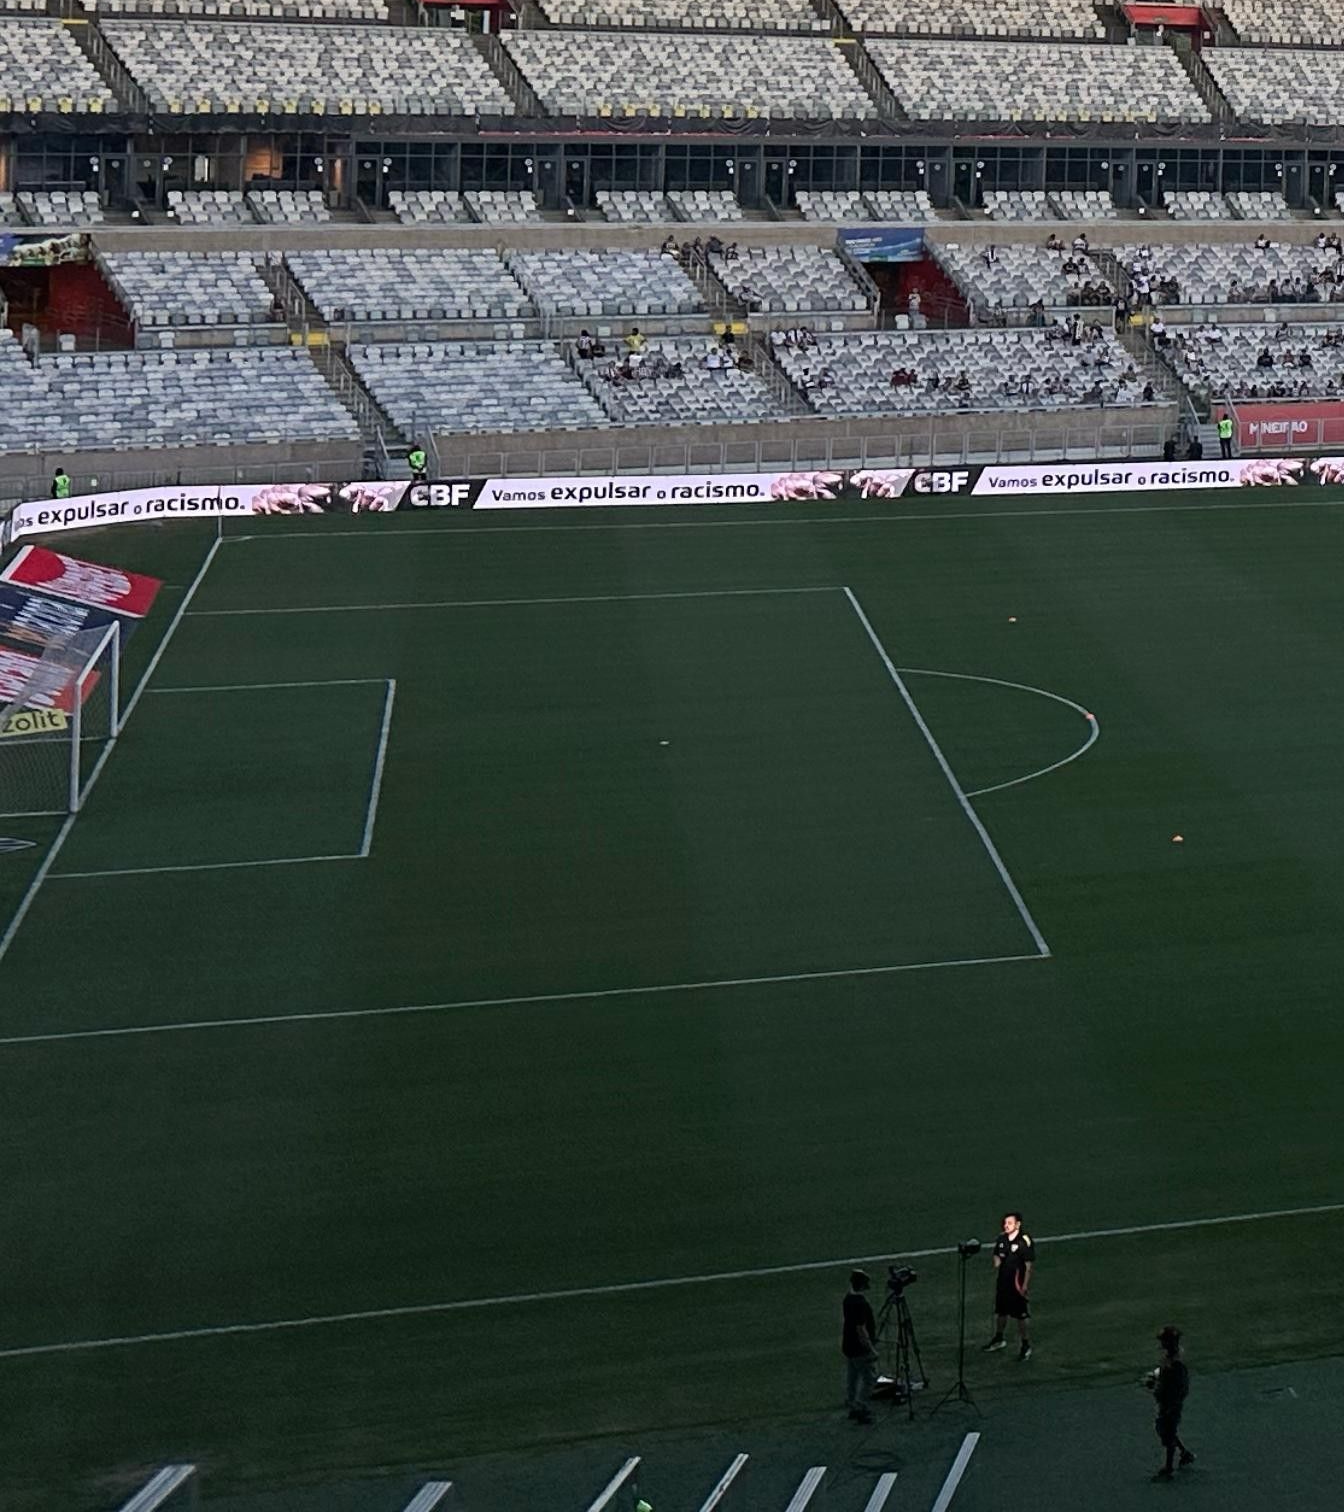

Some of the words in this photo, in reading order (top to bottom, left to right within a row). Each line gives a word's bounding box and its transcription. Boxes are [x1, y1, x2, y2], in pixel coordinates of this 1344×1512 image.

[914, 472, 968, 492] CBF
[989, 477, 1038, 488] Vamos
[1042, 470, 1133, 490] expulsar
[1151, 468, 1235, 484] racismo.
[410, 485, 470, 507] CBF
[492, 489, 545, 501] Vamos
[551, 482, 652, 504] expulsar
[657, 490, 666, 499] o
[672, 481, 764, 497] racismo.
[38, 497, 129, 526] expulsar
[134, 505, 141, 514] o
[146, 494, 245, 512] racismo.
